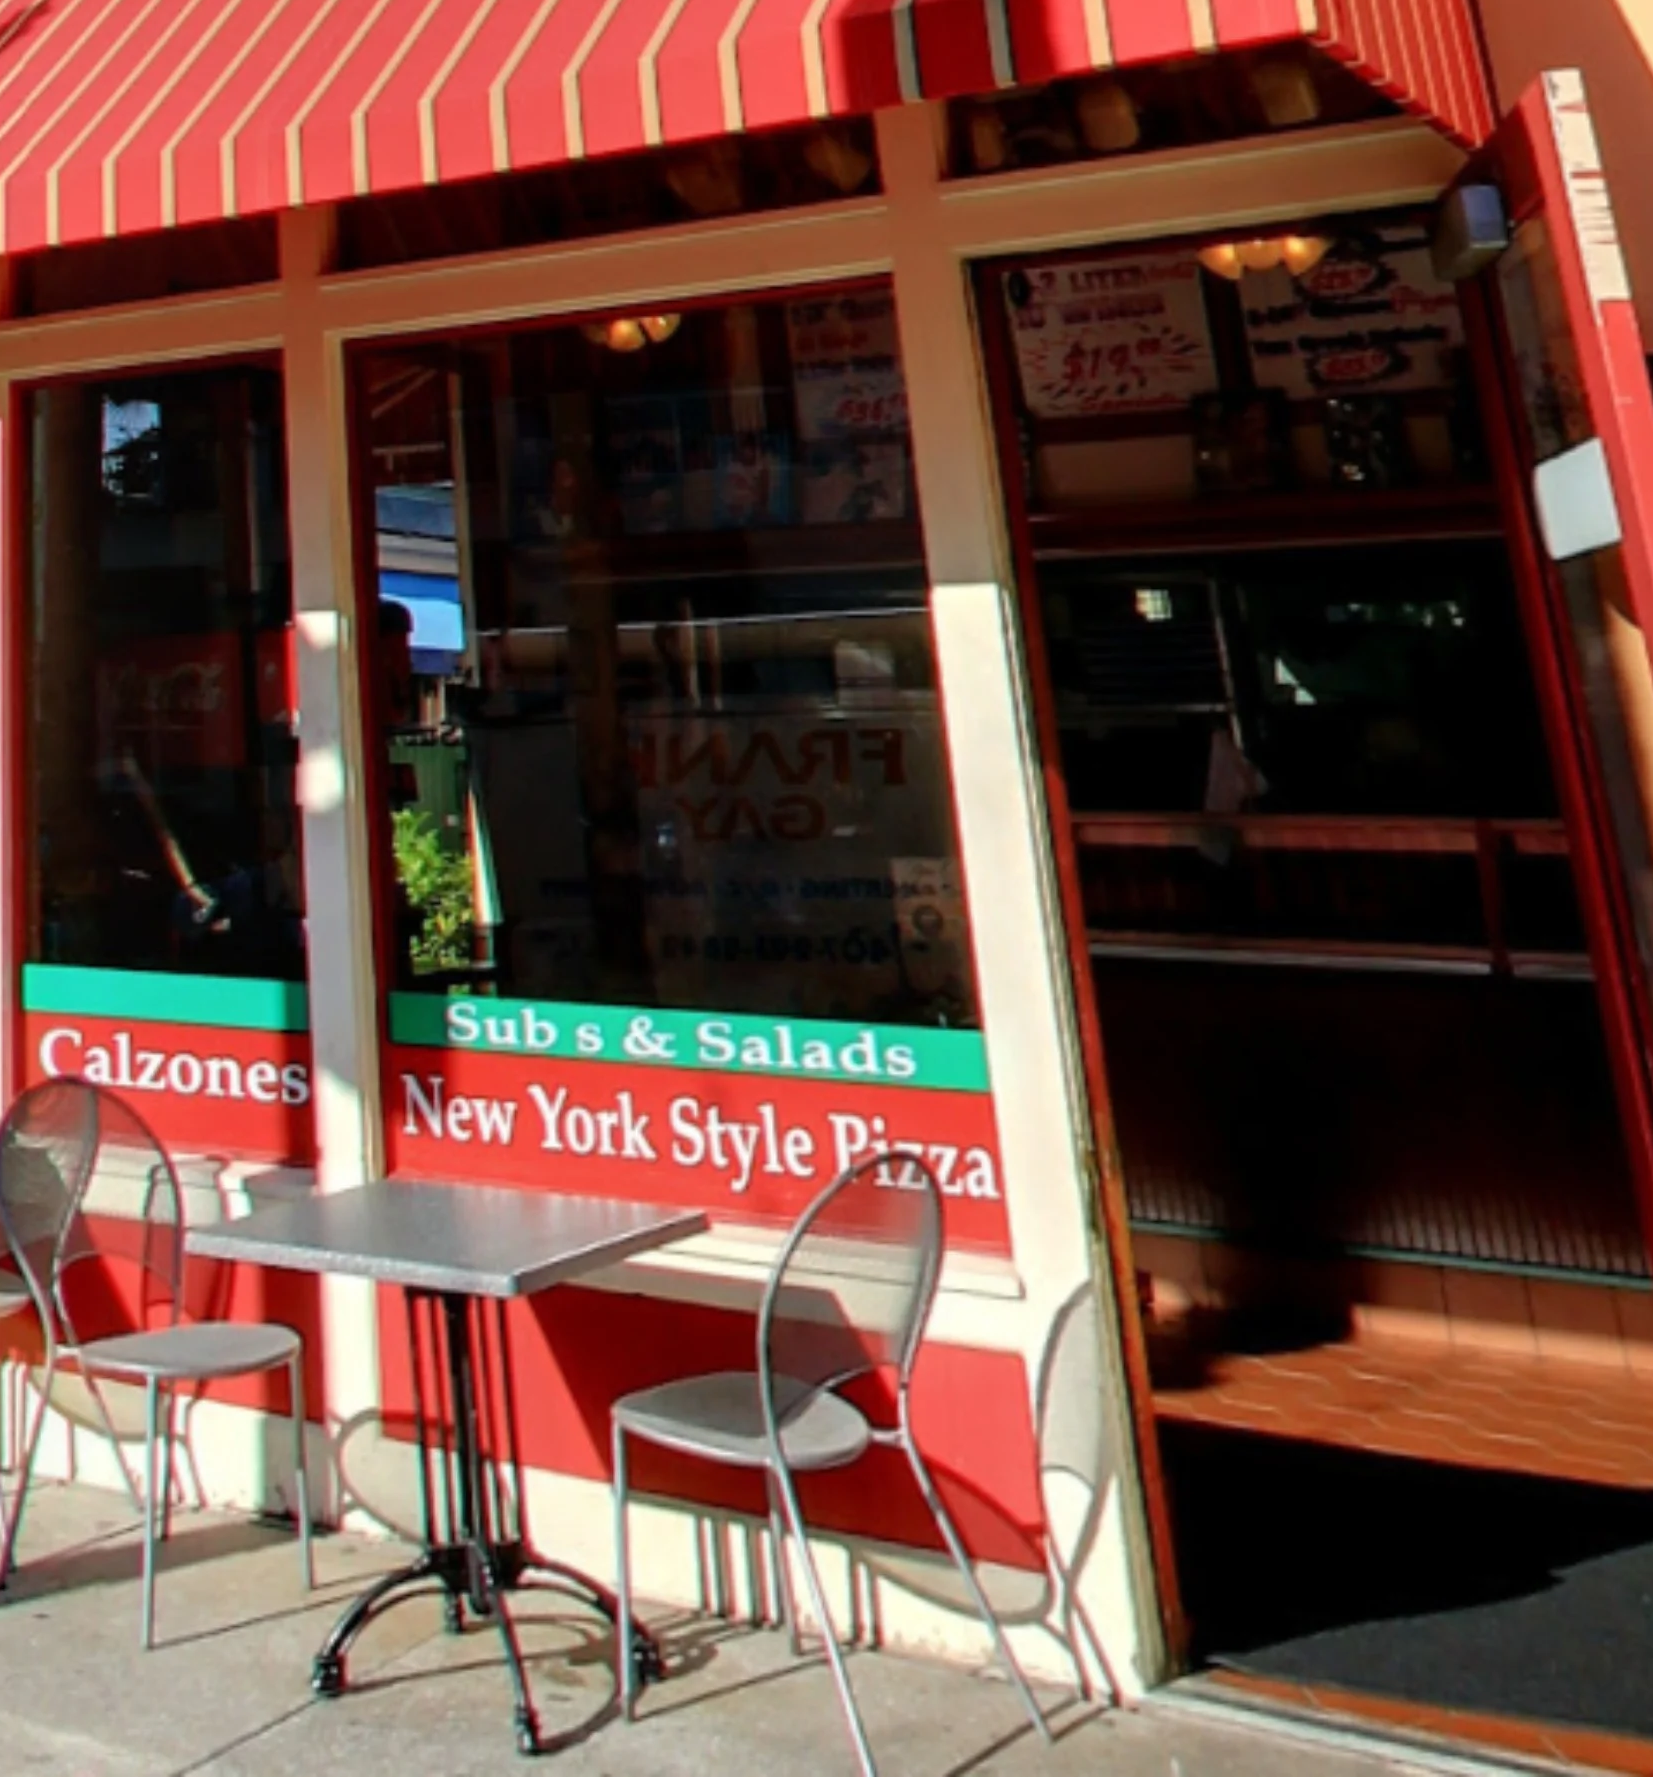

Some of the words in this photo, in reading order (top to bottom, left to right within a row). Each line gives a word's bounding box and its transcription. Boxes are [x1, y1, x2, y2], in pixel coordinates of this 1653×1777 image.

[38, 1028, 310, 1105] Calzones
[623, 1016, 677, 1059] &
[697, 1022, 918, 1078] Salads
[401, 1073, 517, 1146] New
[527, 1083, 657, 1161] York
[669, 1096, 816, 1193] Style
[828, 1113, 1001, 1200] Pizza
